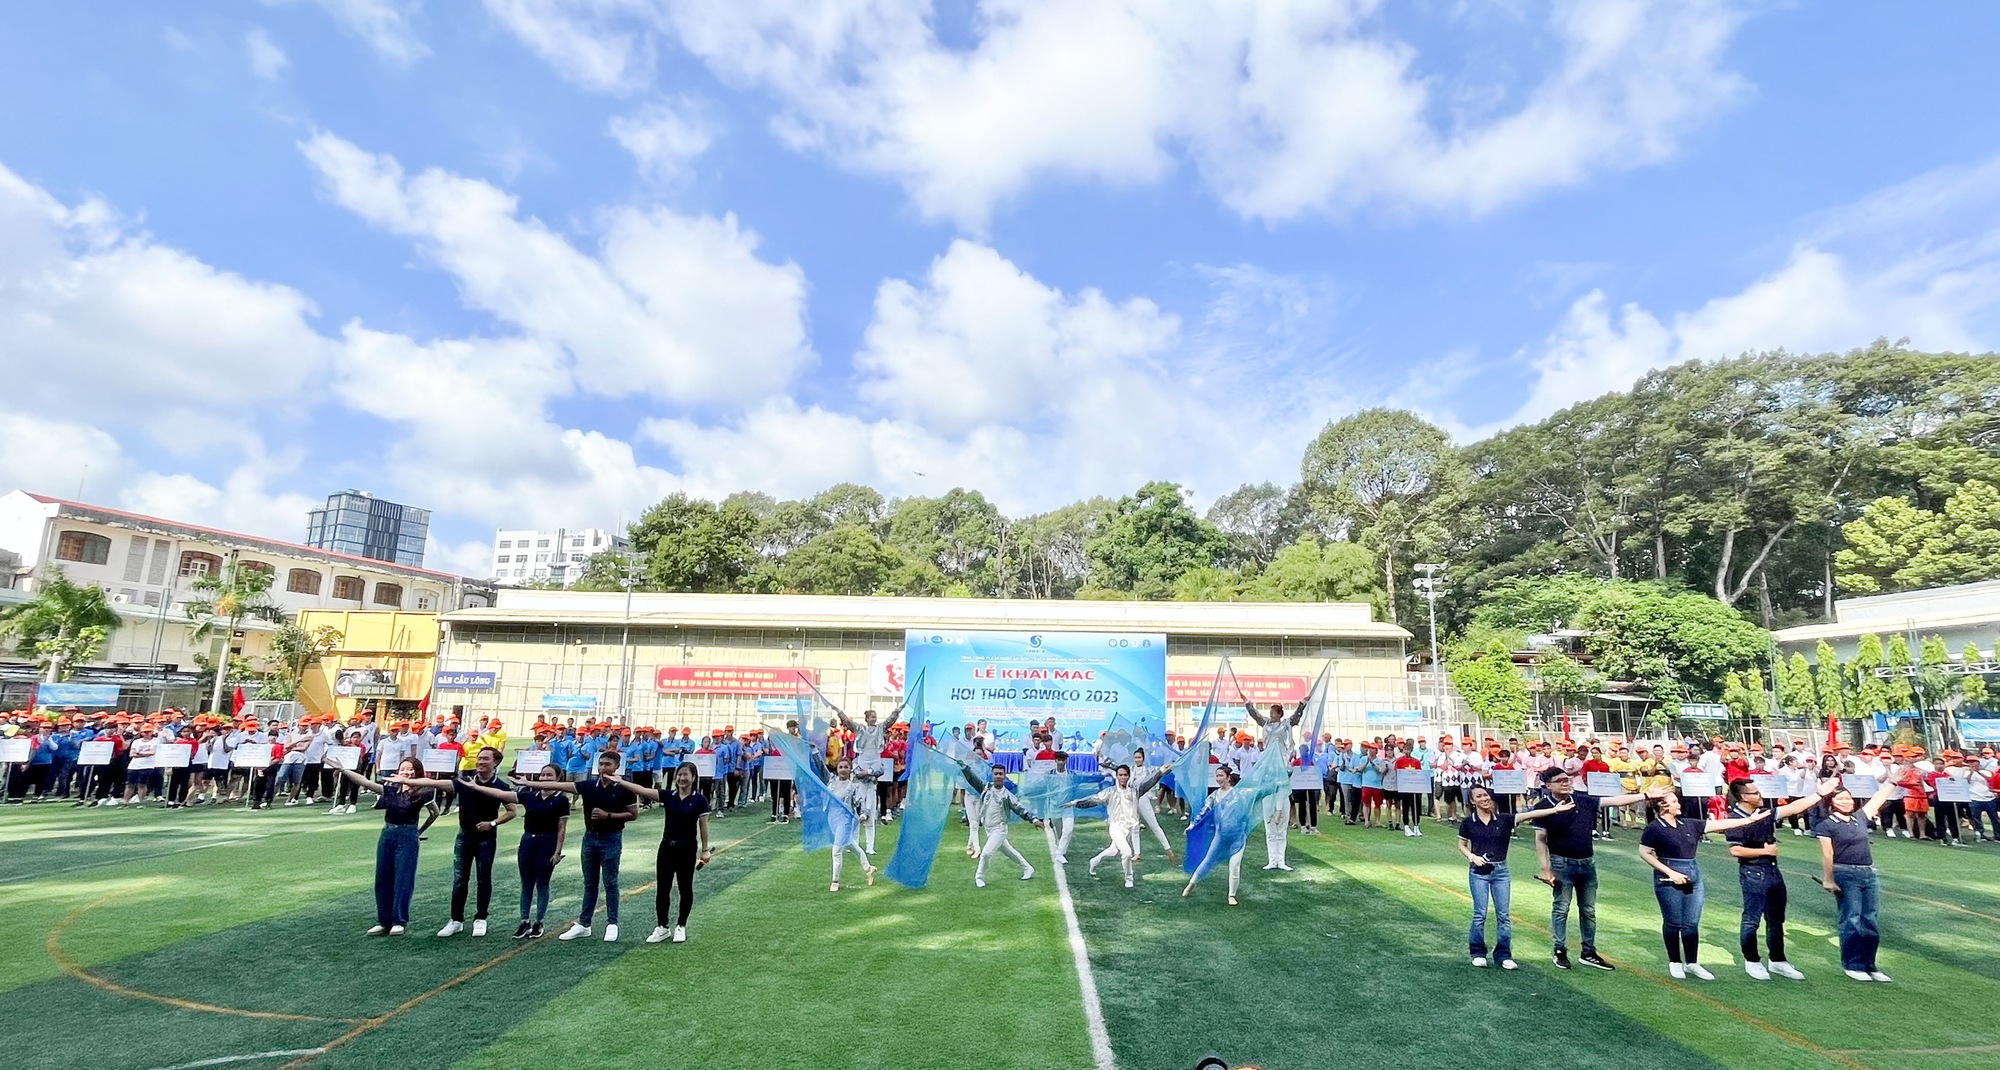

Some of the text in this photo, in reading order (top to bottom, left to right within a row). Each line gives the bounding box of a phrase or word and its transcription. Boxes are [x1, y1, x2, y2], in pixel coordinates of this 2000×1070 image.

[438, 674, 490, 685] SÂN CẦU LÔNG
[974, 664, 1096, 682] LỄ KHAI MẠC
[950, 685, 1118, 703] HỘI THAO SAWACO 2023
